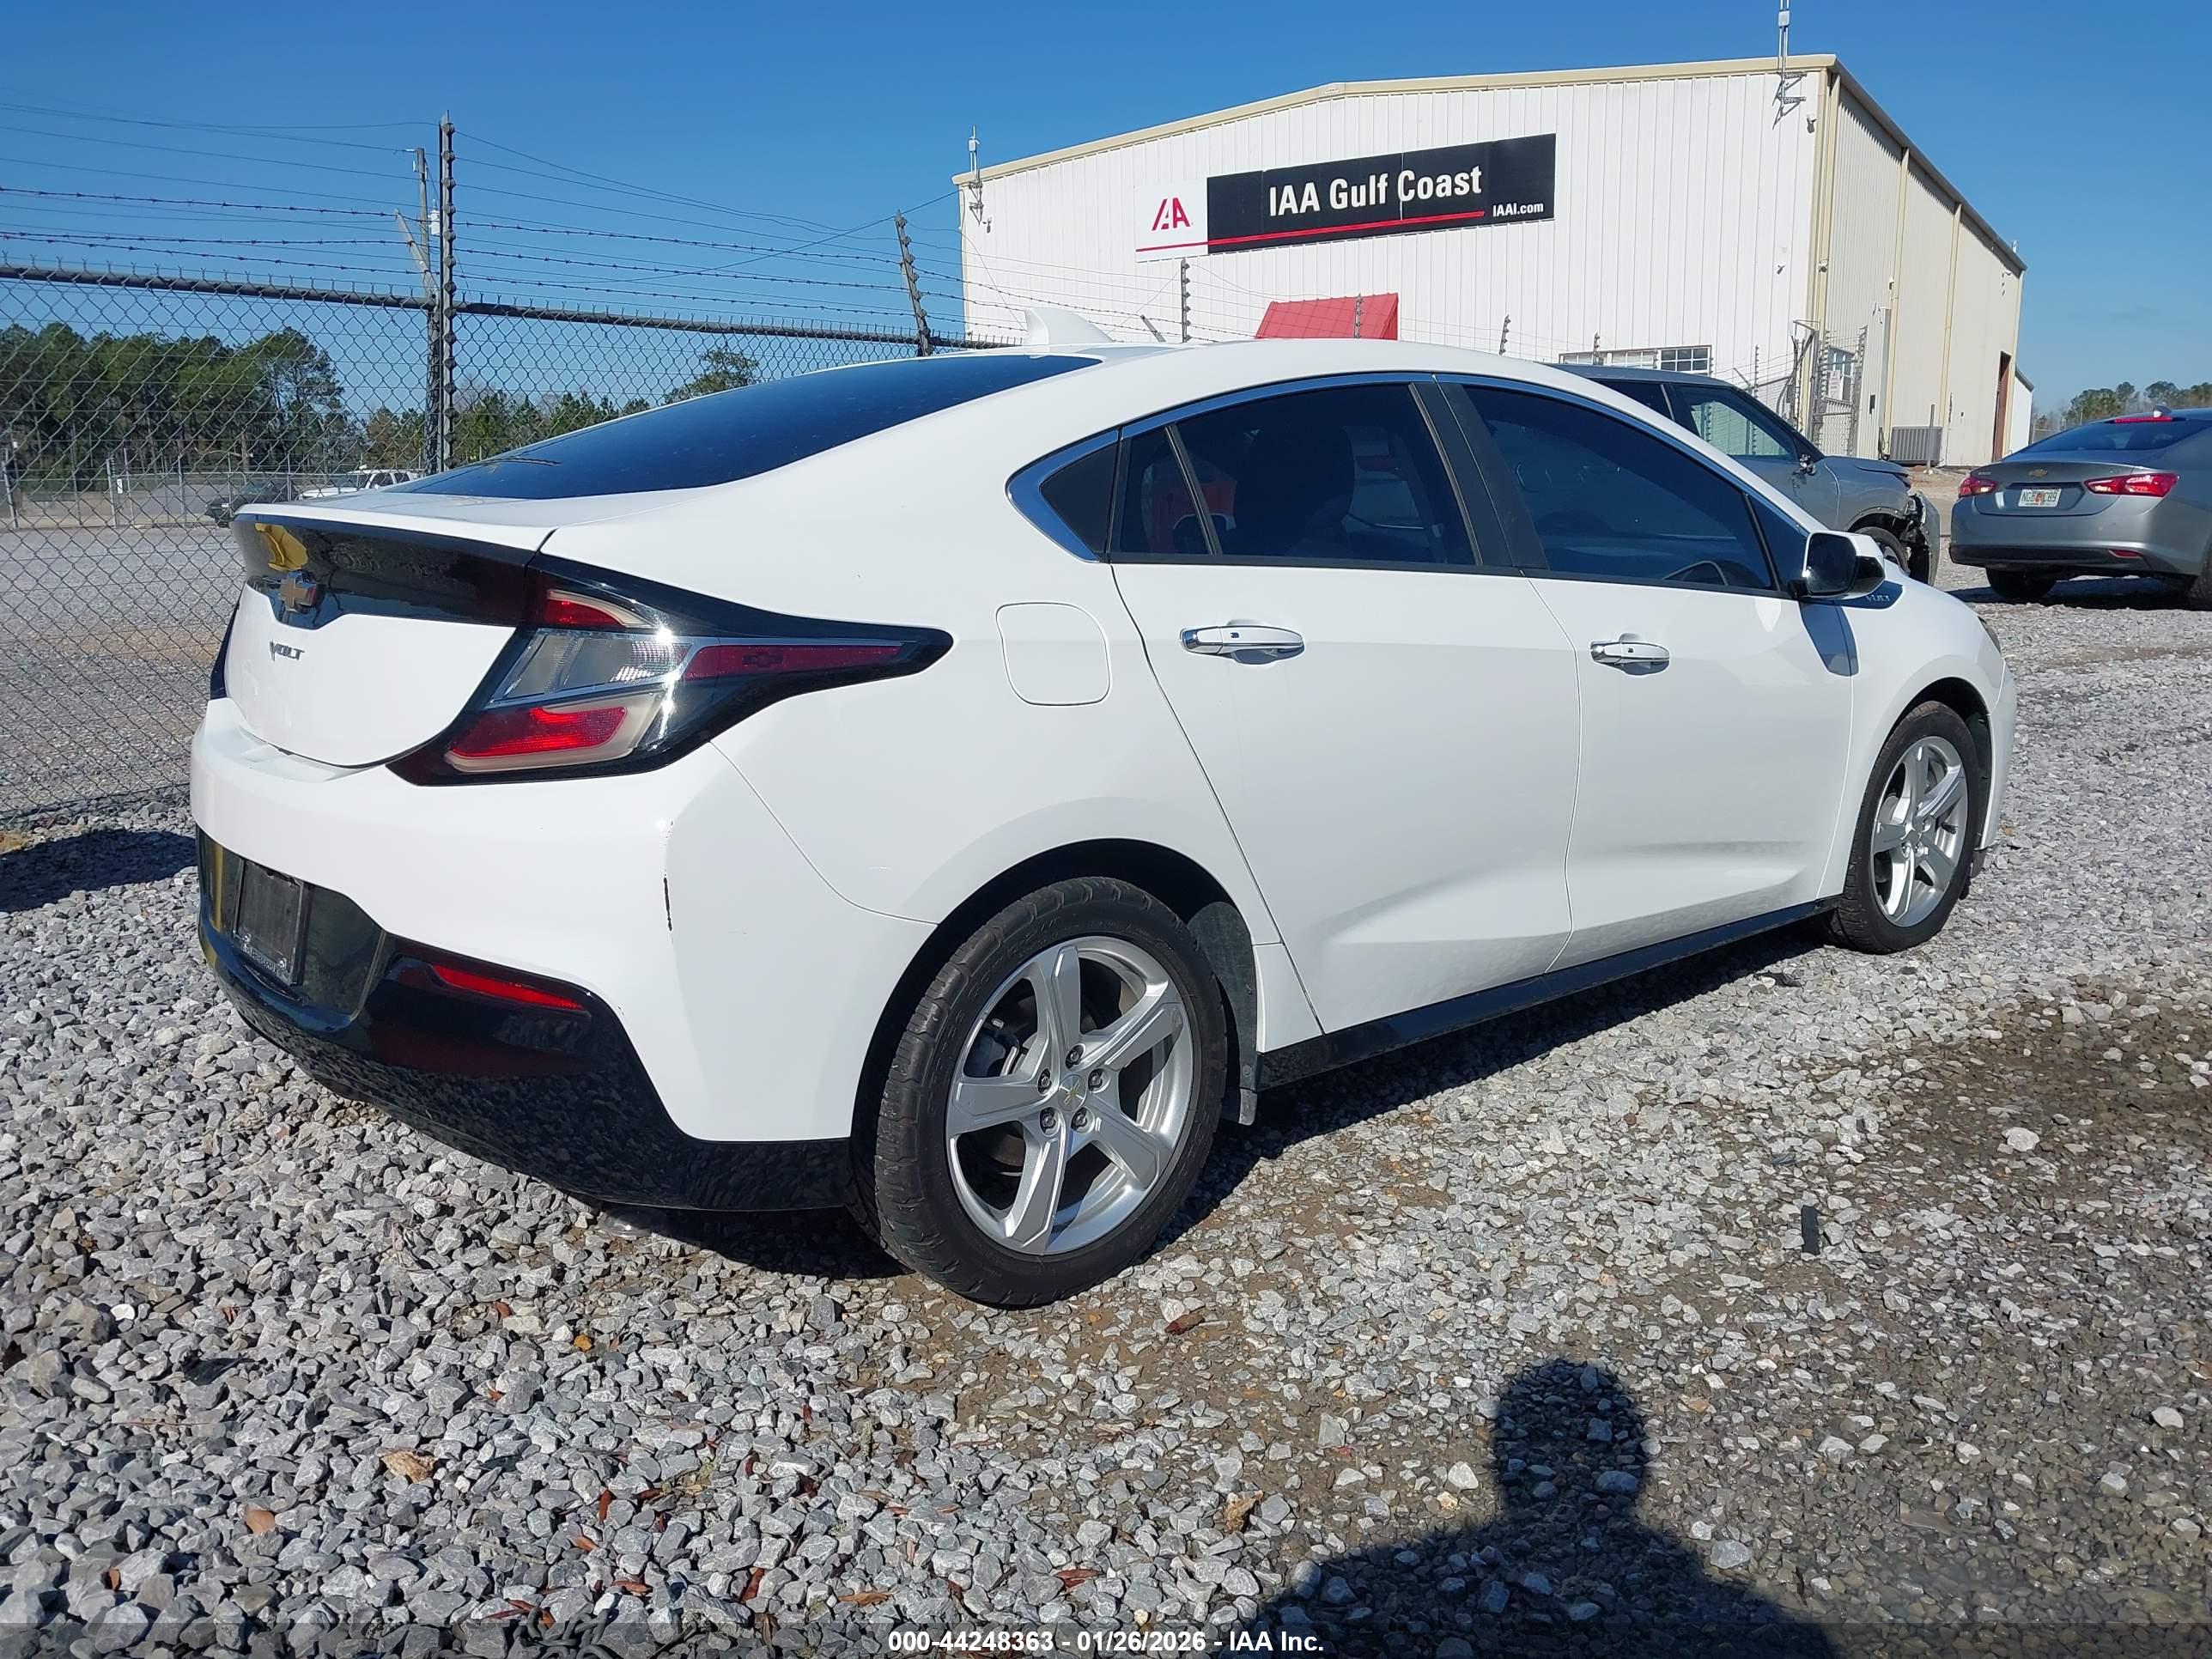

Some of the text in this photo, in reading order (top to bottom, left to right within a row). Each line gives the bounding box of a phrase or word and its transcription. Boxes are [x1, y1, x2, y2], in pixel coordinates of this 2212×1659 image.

[1269, 165, 1482, 216] IAA Gulf Coast
[1492, 203, 1544, 217] IAAI.com
[269, 640, 305, 662] VOLT
